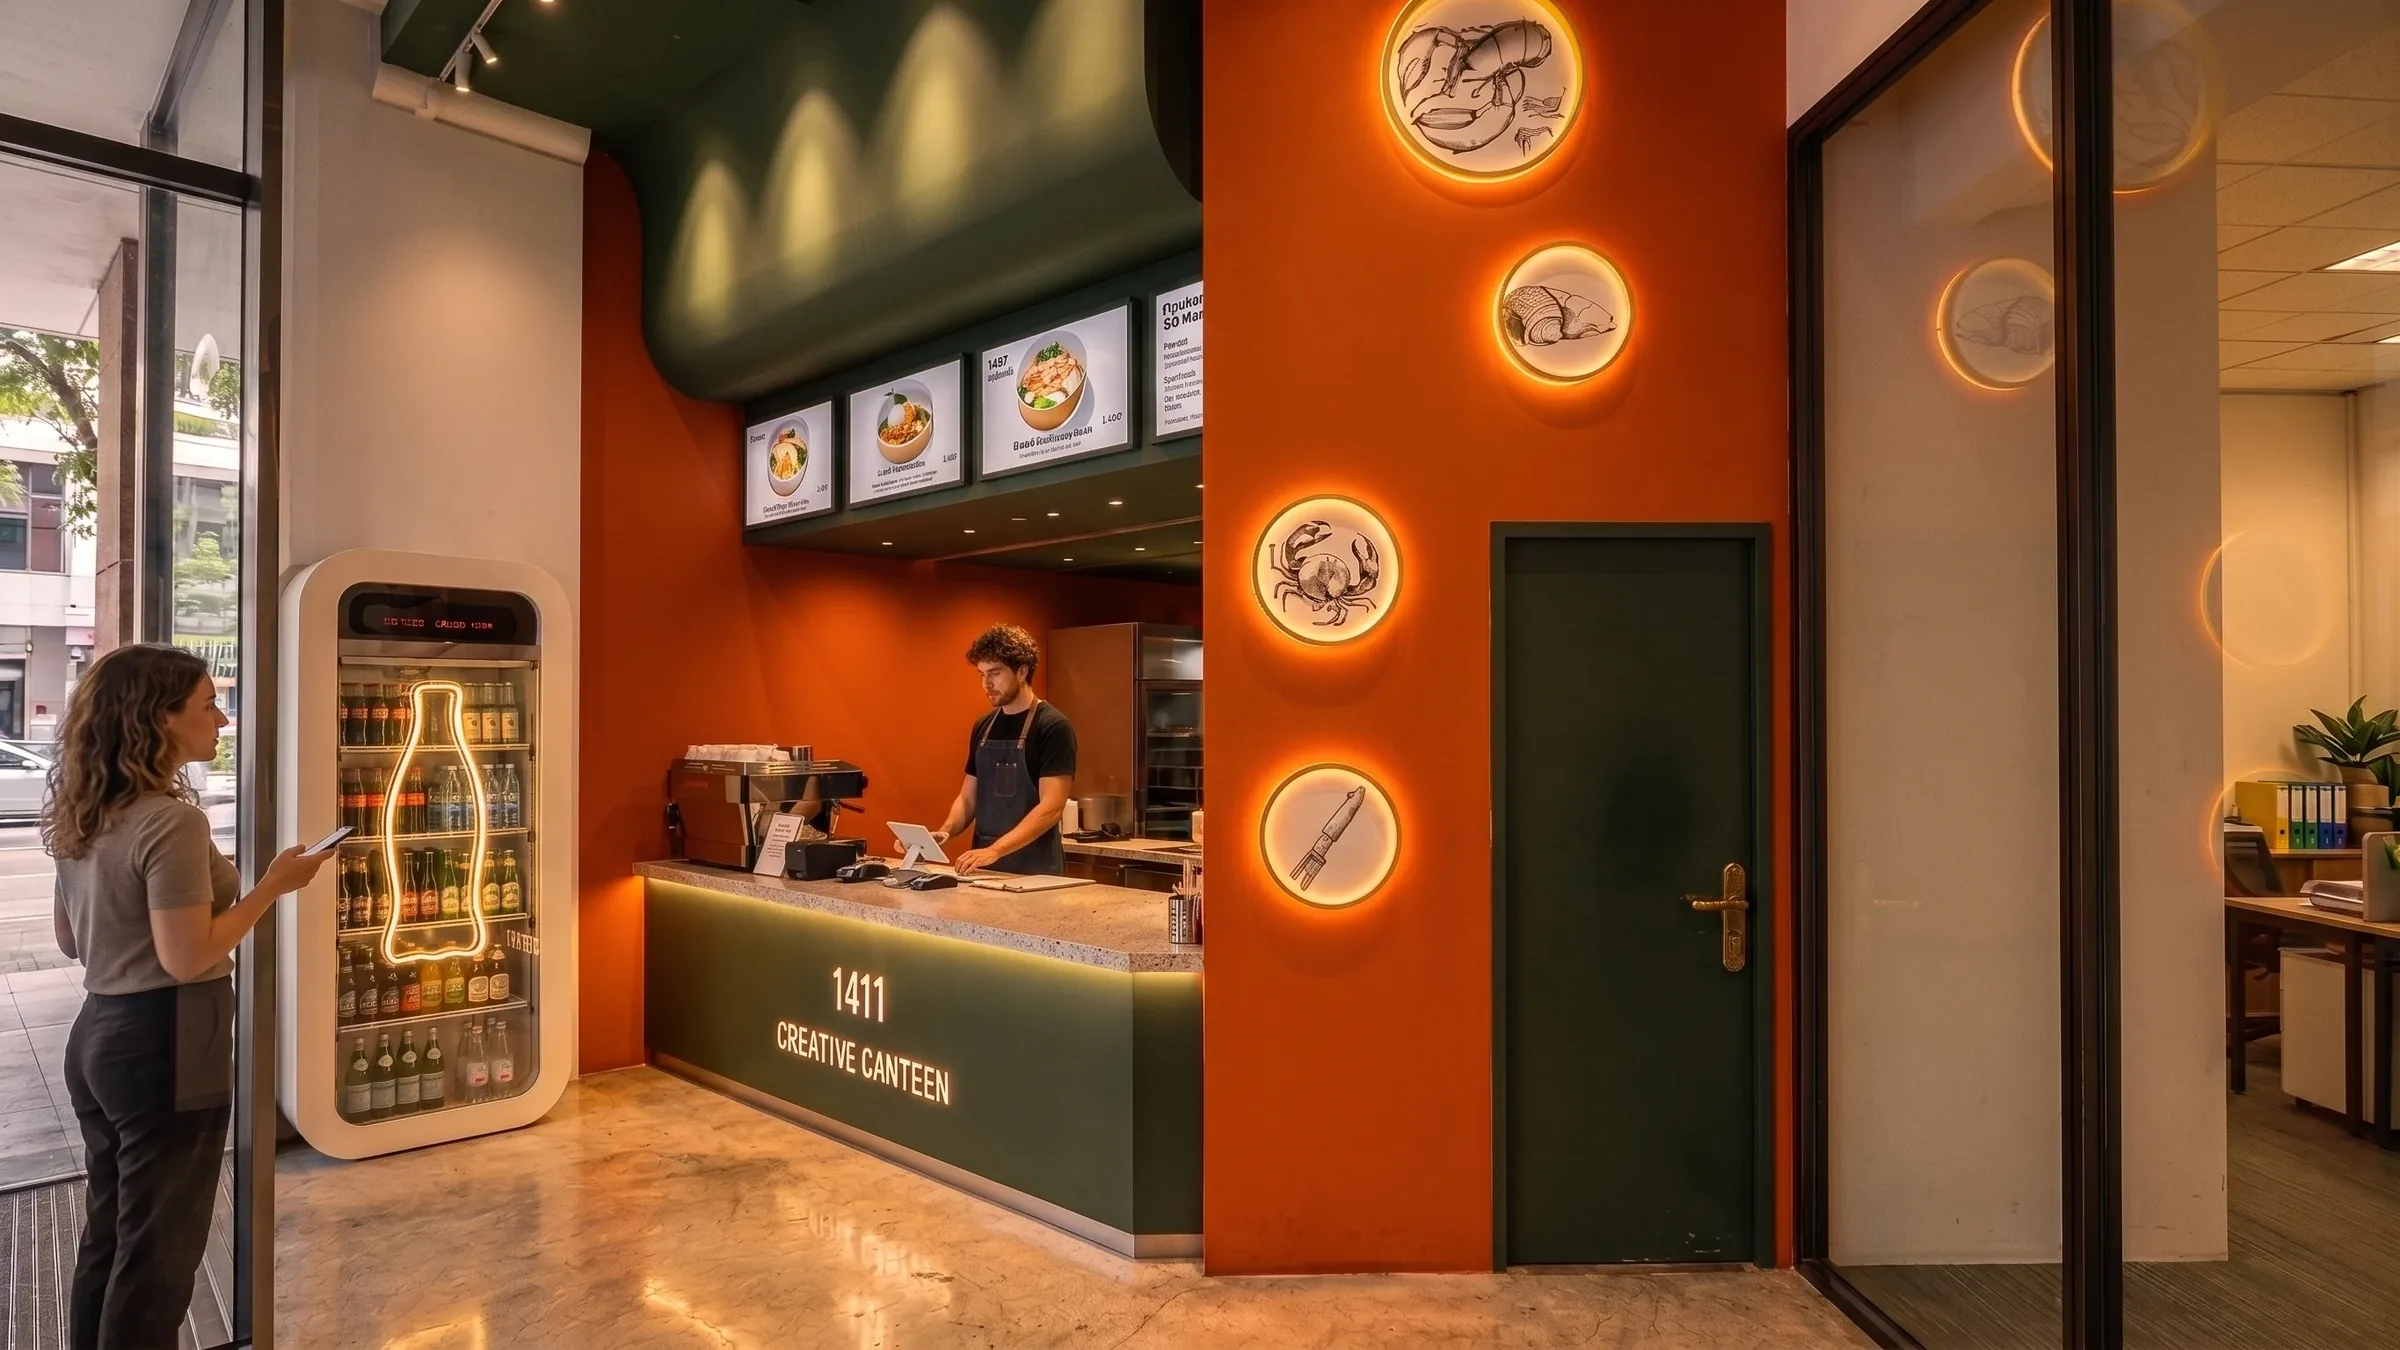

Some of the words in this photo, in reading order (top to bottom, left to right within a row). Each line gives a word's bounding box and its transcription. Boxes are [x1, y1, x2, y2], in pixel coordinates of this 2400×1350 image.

[832, 966, 884, 1023] 1411
[777, 1021, 856, 1074] CREATIVE
[861, 1047, 949, 1105] CANTEEN
